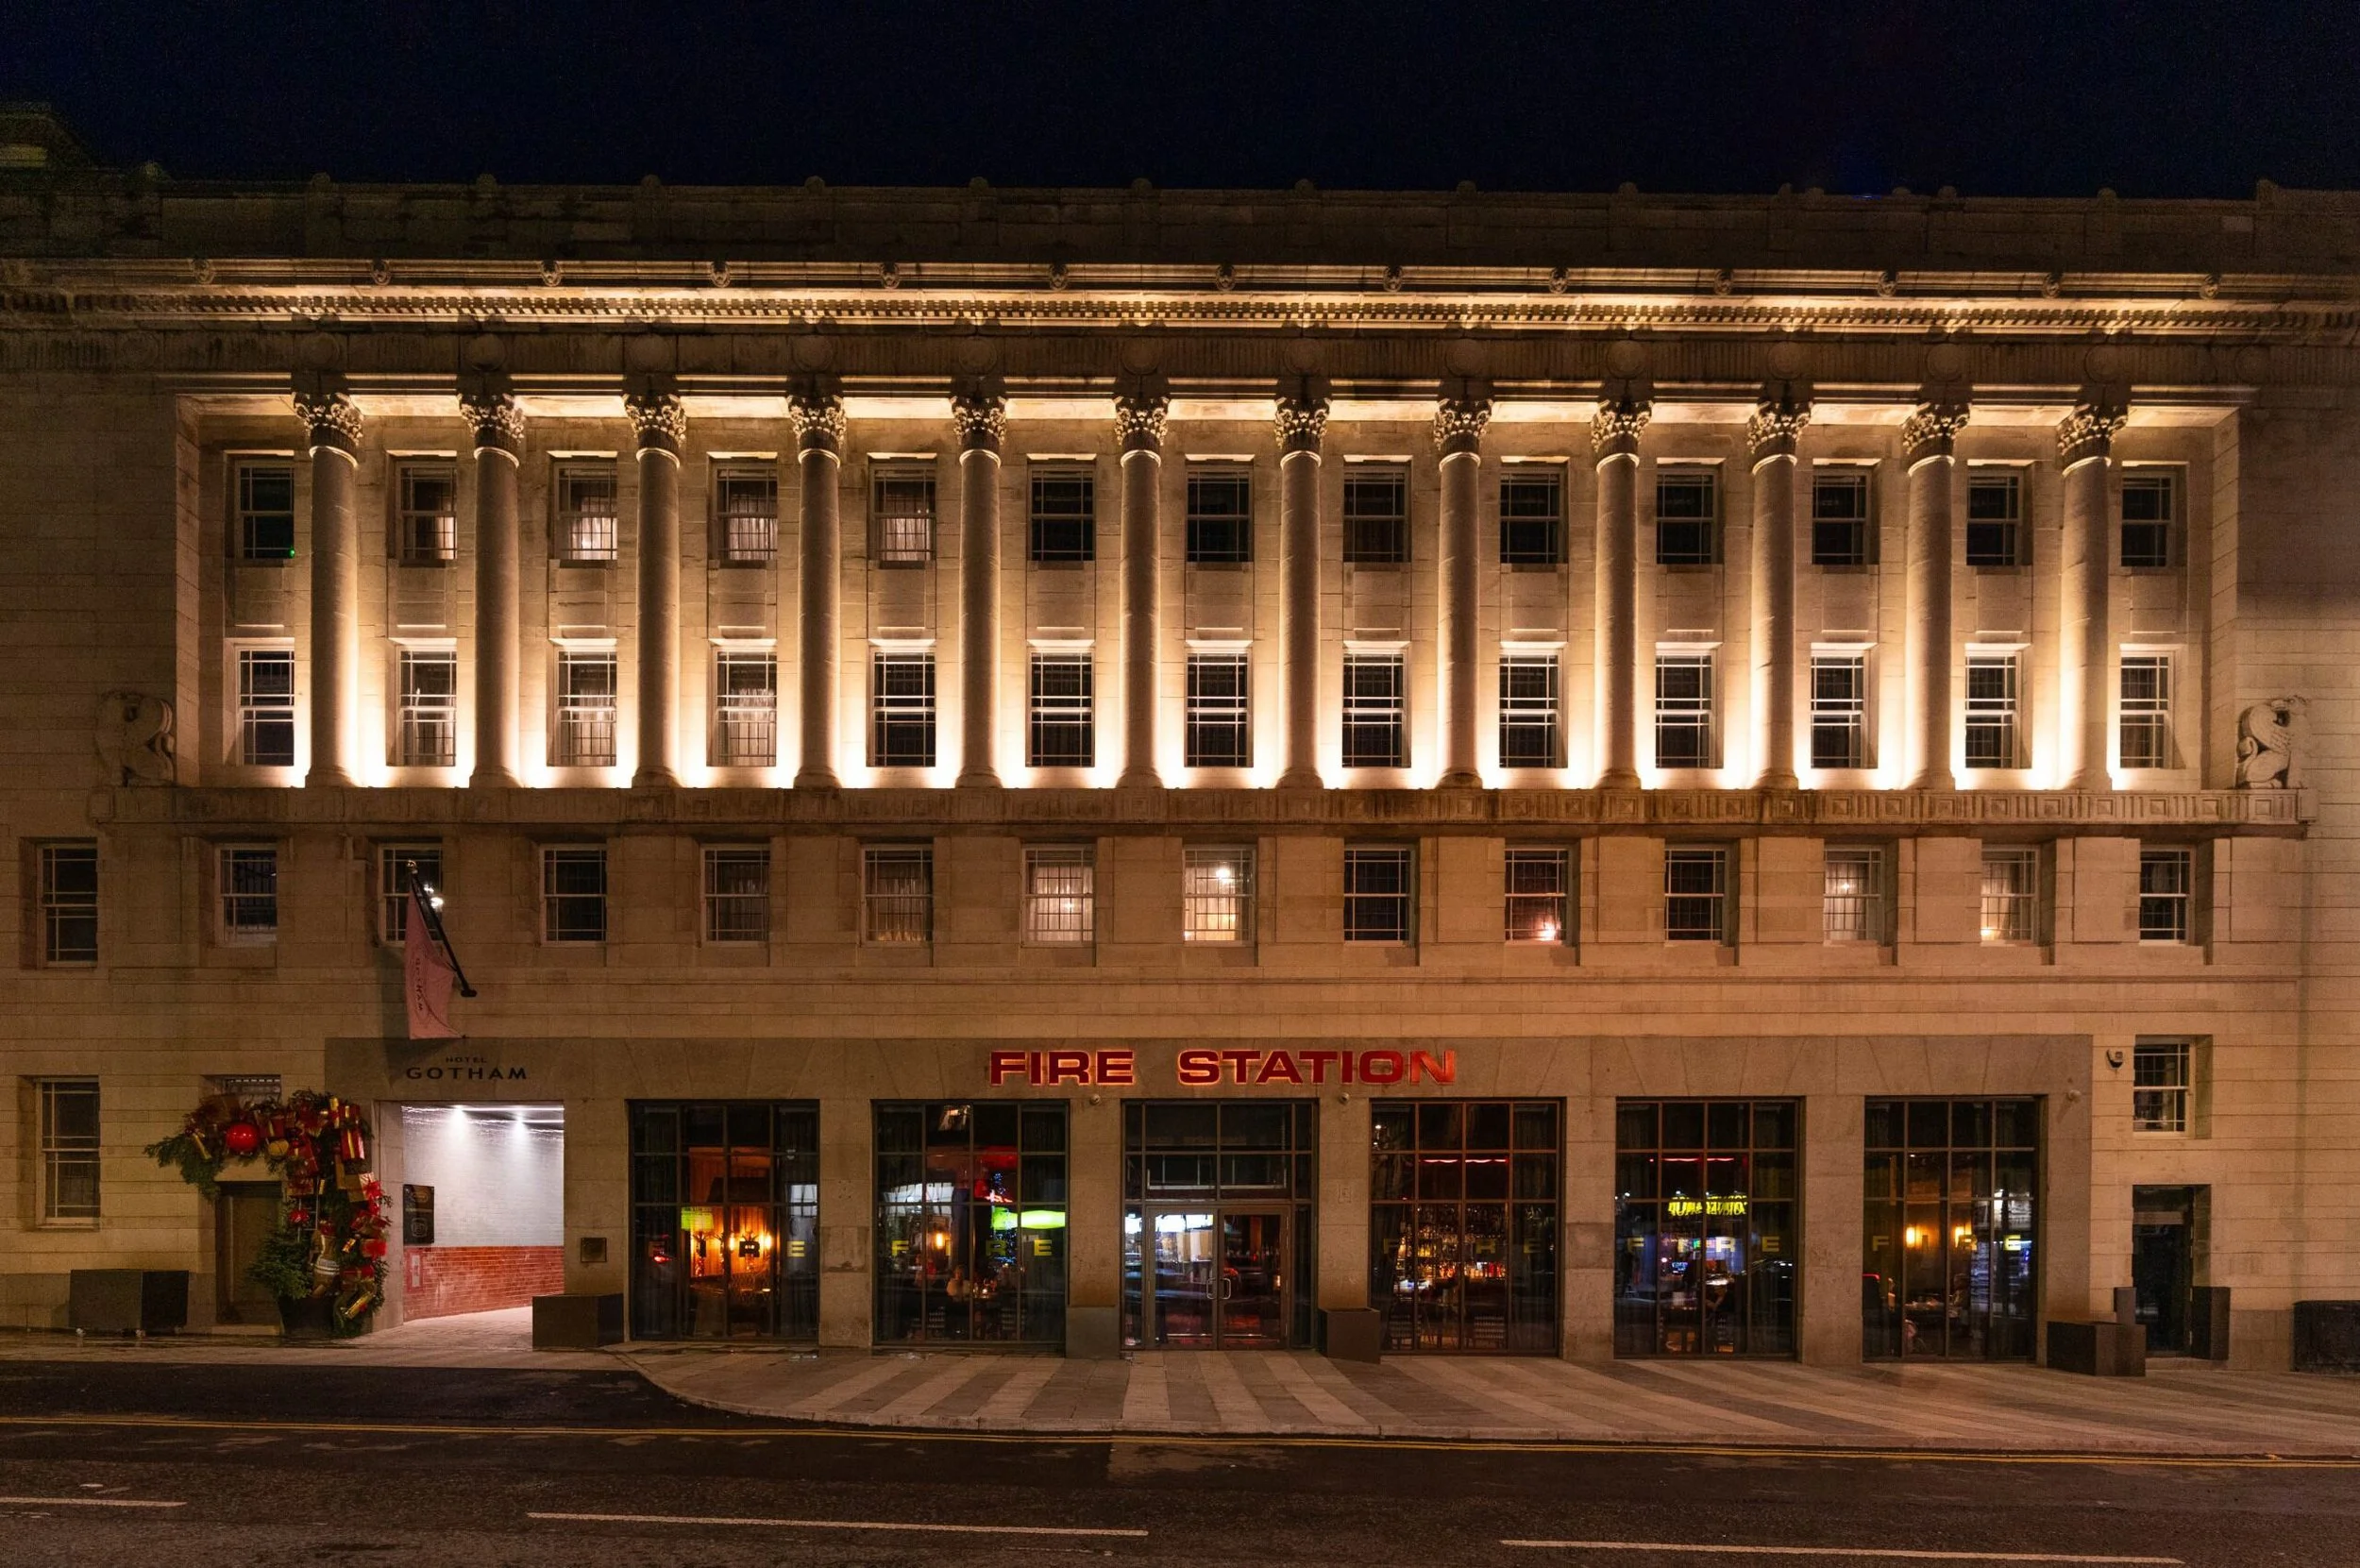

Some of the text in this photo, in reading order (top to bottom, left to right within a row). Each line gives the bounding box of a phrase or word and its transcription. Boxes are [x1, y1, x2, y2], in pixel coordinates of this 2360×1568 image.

[406, 1067, 527, 1080] GOTHAM
[989, 1049, 1457, 1086] FIRE STATION
